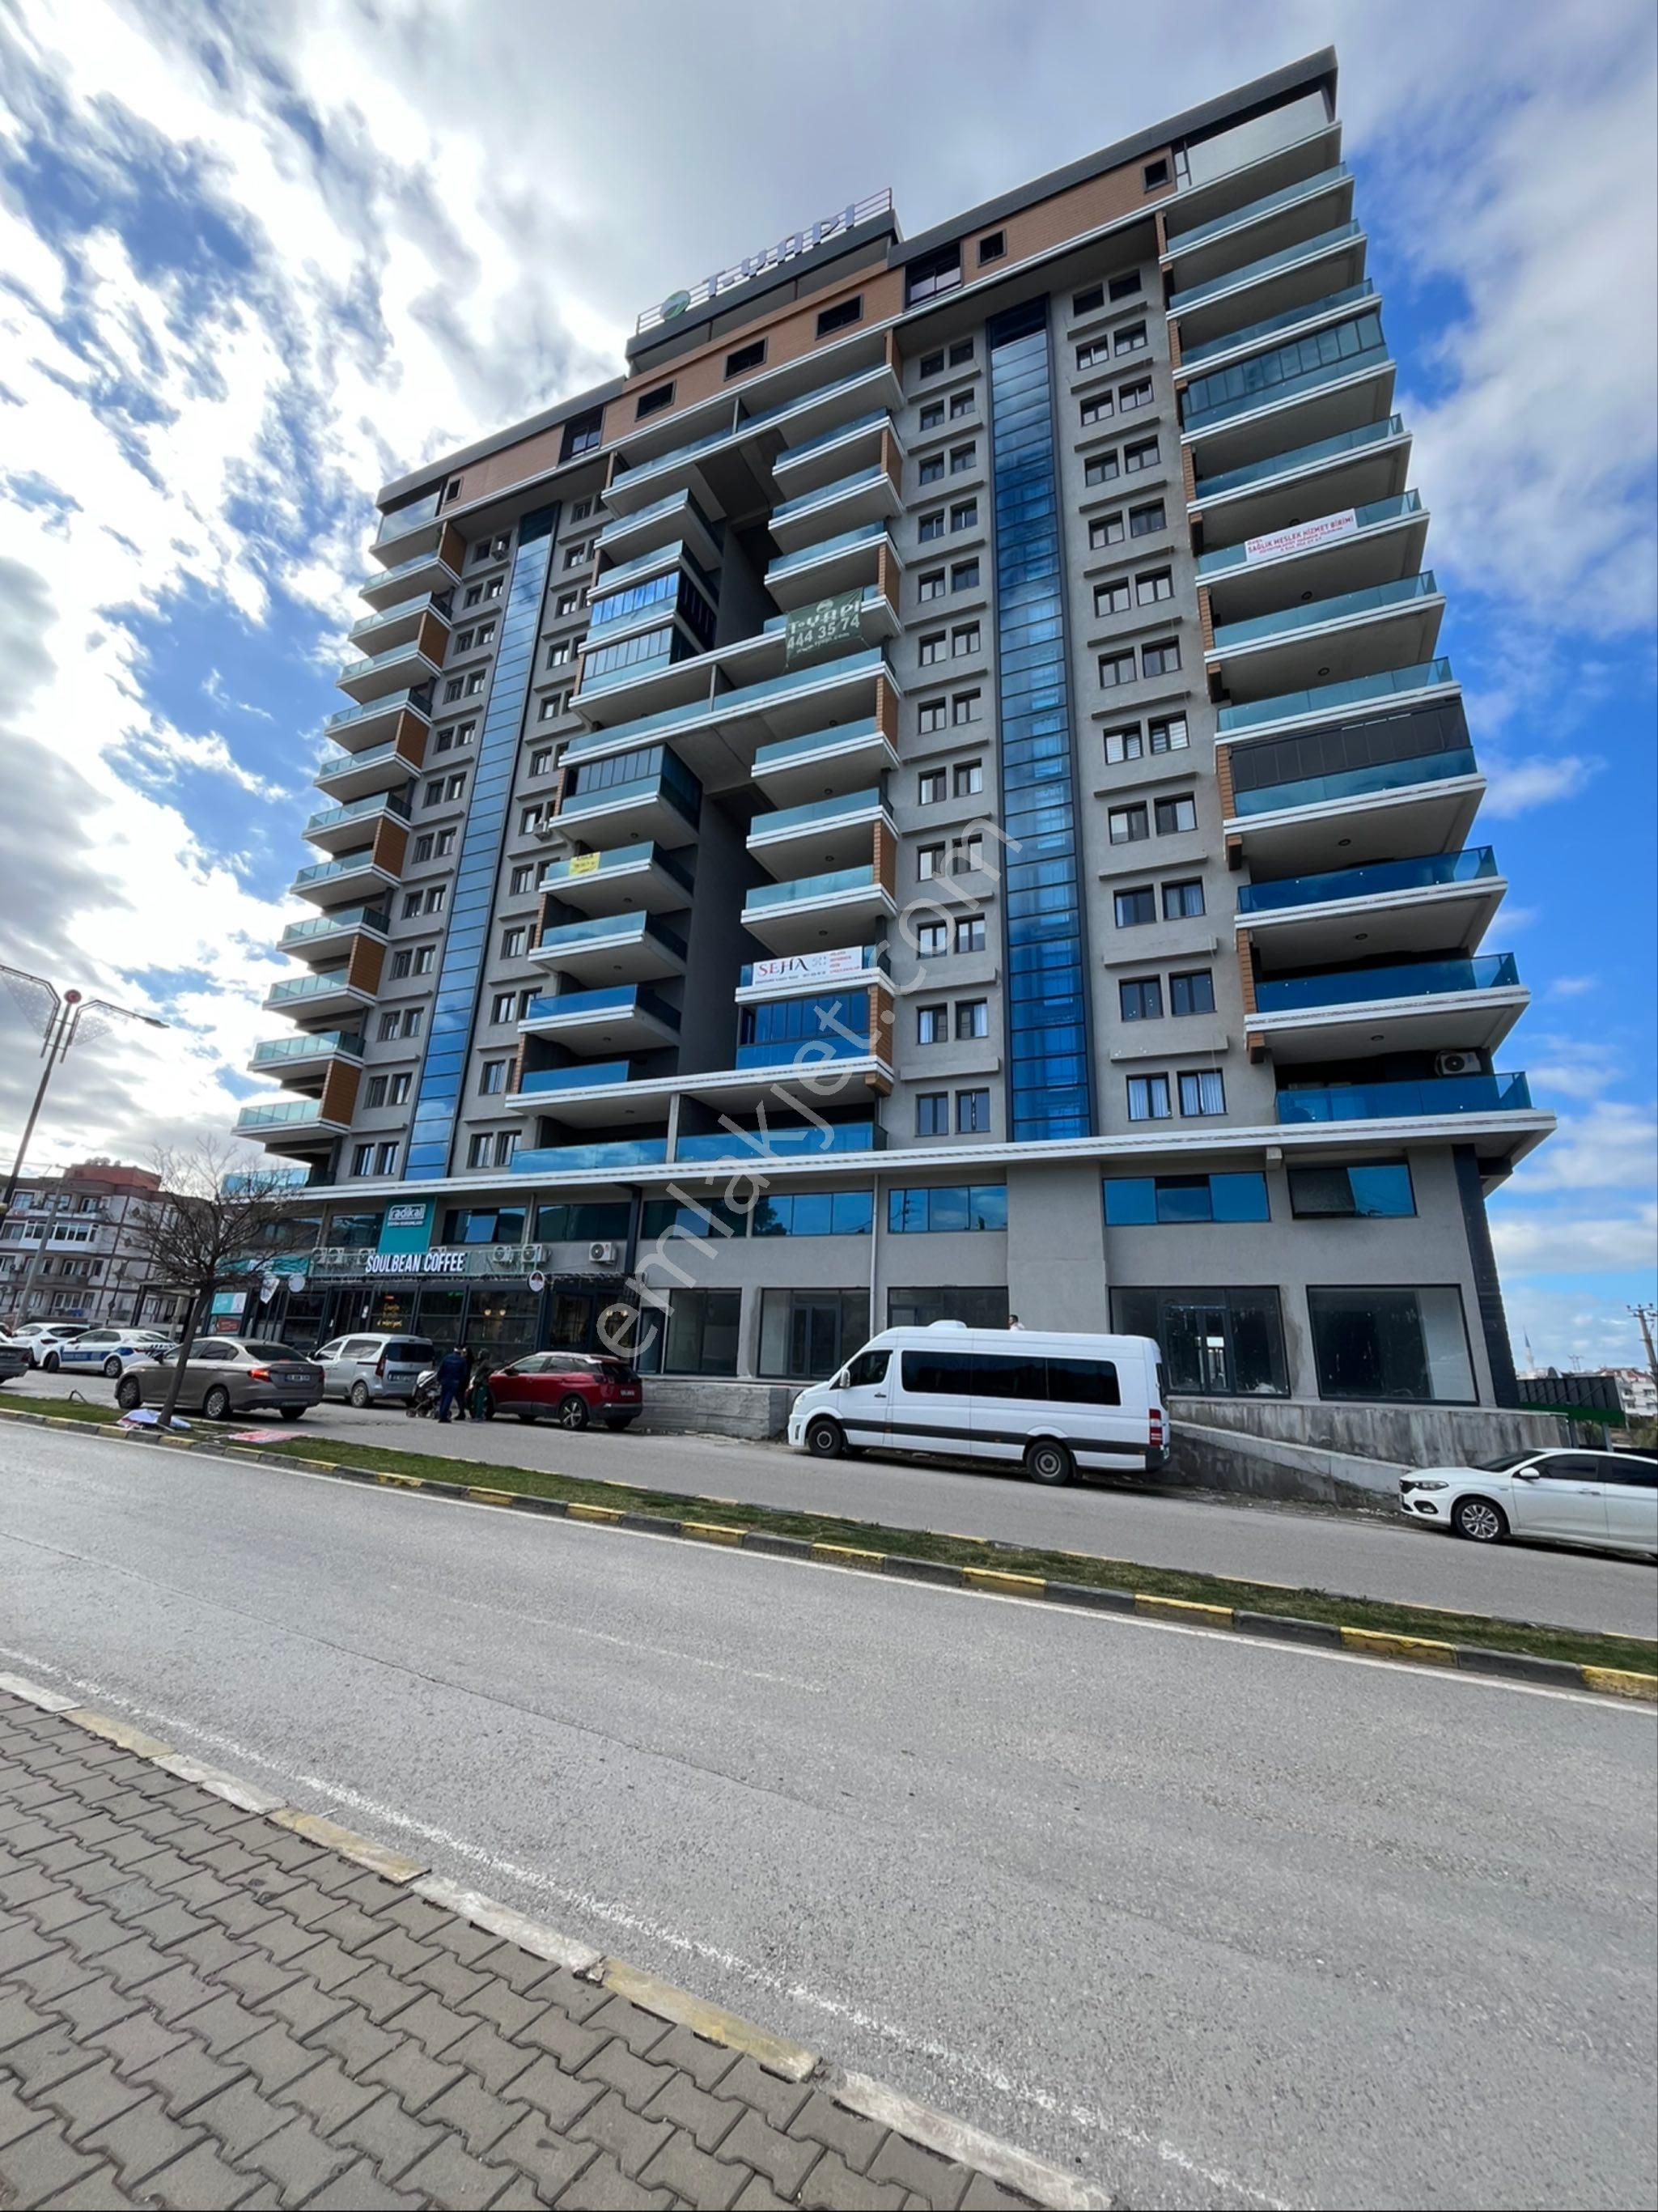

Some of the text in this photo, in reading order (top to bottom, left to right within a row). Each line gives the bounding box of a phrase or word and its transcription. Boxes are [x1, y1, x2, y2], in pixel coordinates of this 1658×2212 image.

[787, 614, 860, 650] 444 35 74
[366, 1252, 466, 1273] SOULBEAN COFFEE
